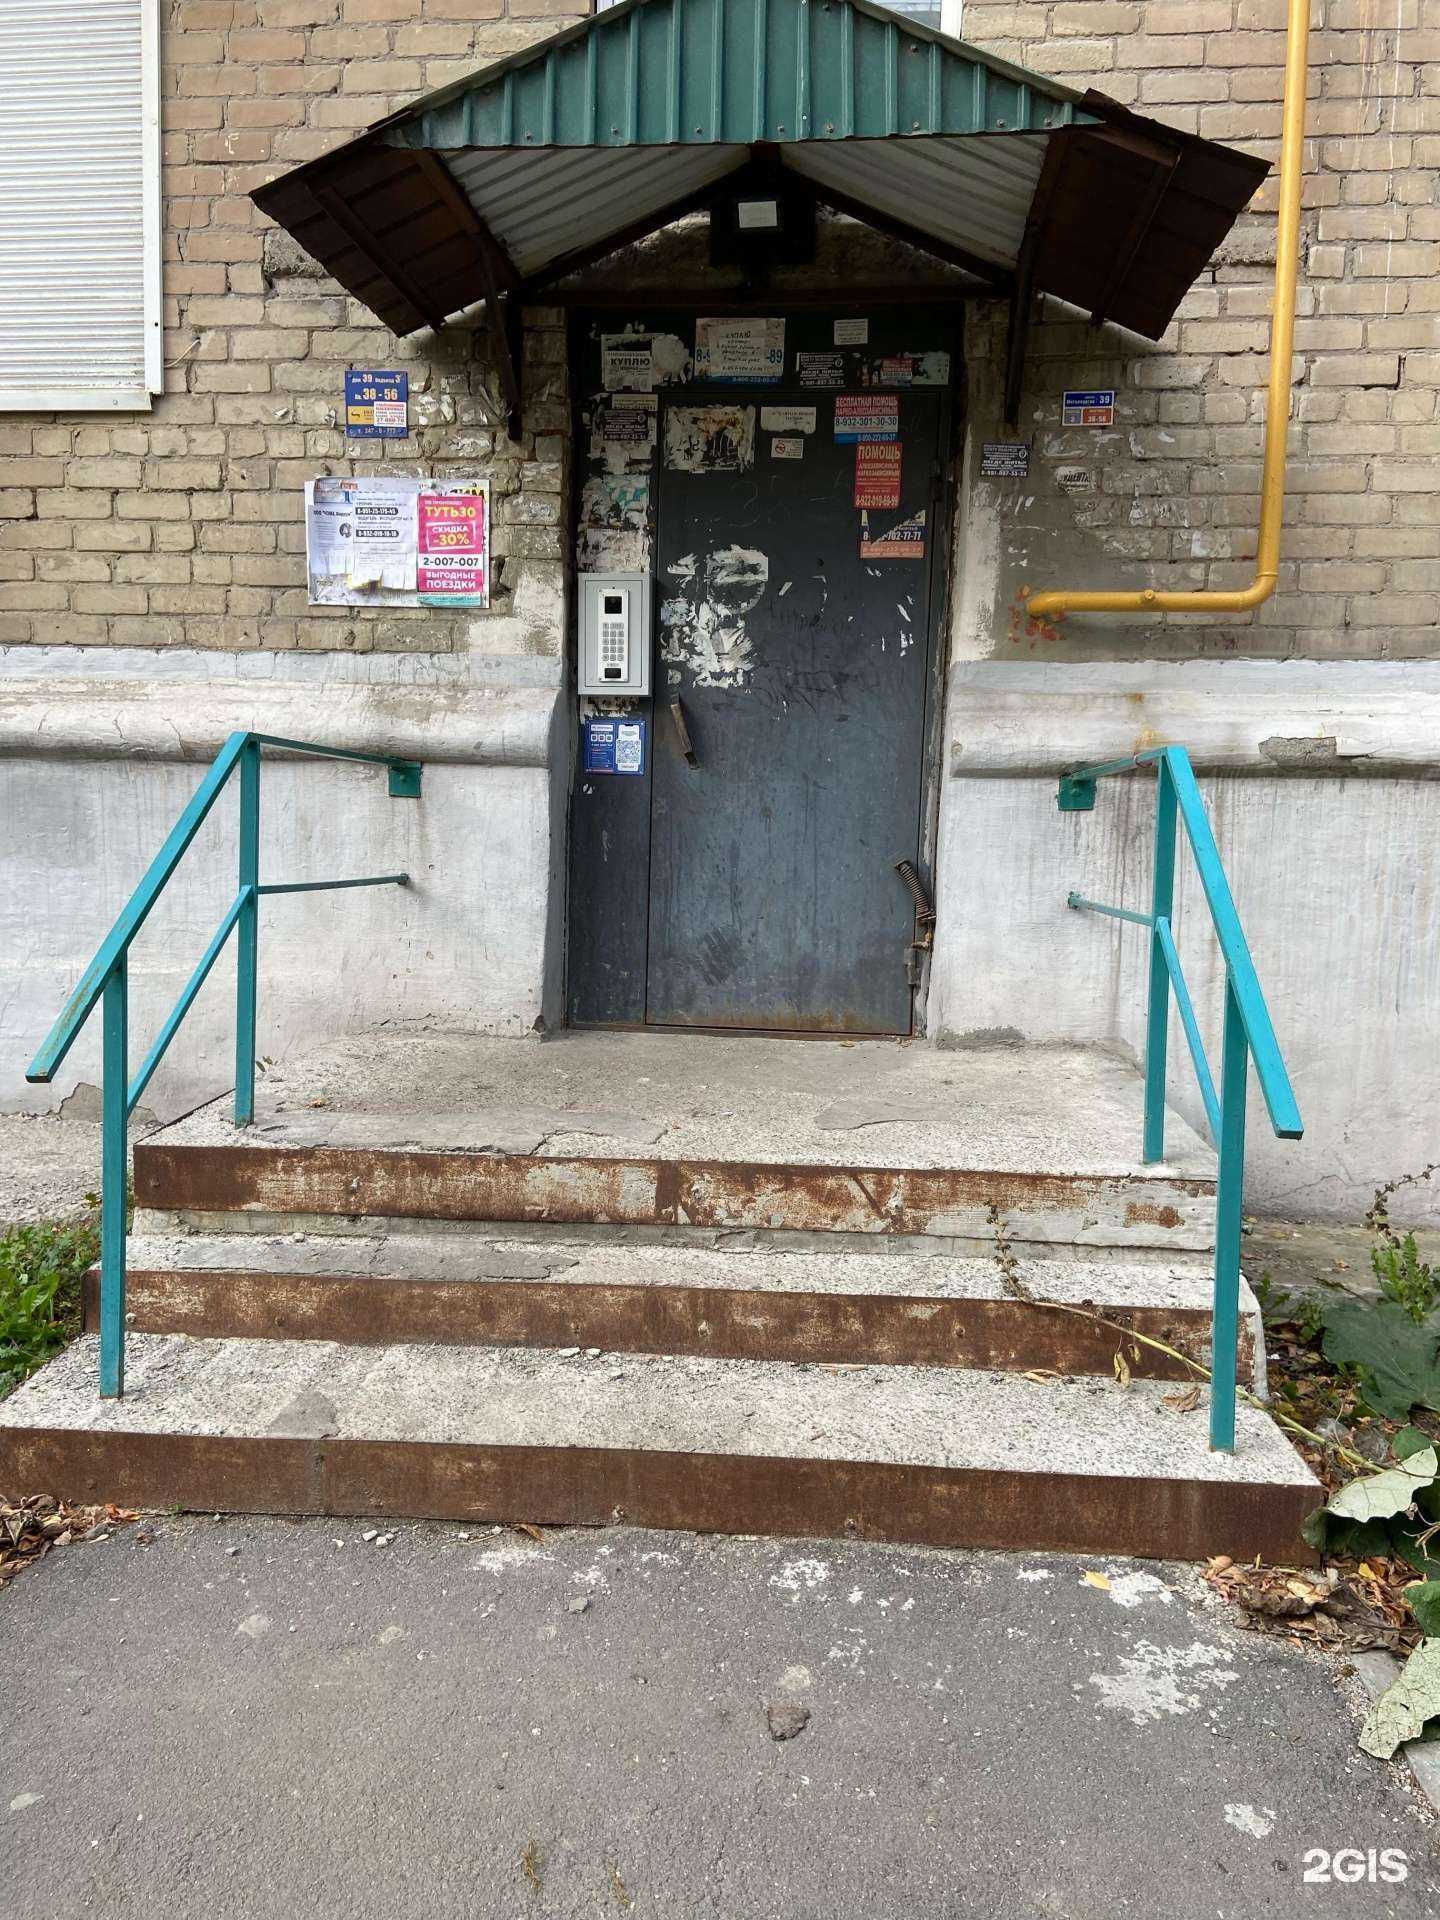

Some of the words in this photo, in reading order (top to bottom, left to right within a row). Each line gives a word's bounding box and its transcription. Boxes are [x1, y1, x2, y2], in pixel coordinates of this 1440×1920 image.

[610, 357, 650, 366] КУПЛЮ
[362, 374, 373, 383] 39
[395, 374, 401, 383] 3
[384, 388, 398, 400] 56
[836, 396, 872, 407] БЕСПЛАТНАЯ
[873, 395, 898, 407] ПОМОЩЬ
[1099, 395, 1110, 404] 39
[835, 417, 897, 426] 8-932-301-30-30
[858, 445, 901, 462] ПОМОЩЬ
[432, 525, 469, 534] СКИДКА
[433, 534, 470, 546] -30%
[423, 557, 479, 567] 2-007-007
[426, 571, 476, 580] ВЫГОДНЫЕ
[426, 580, 476, 591] ПОЕЗДКИ
